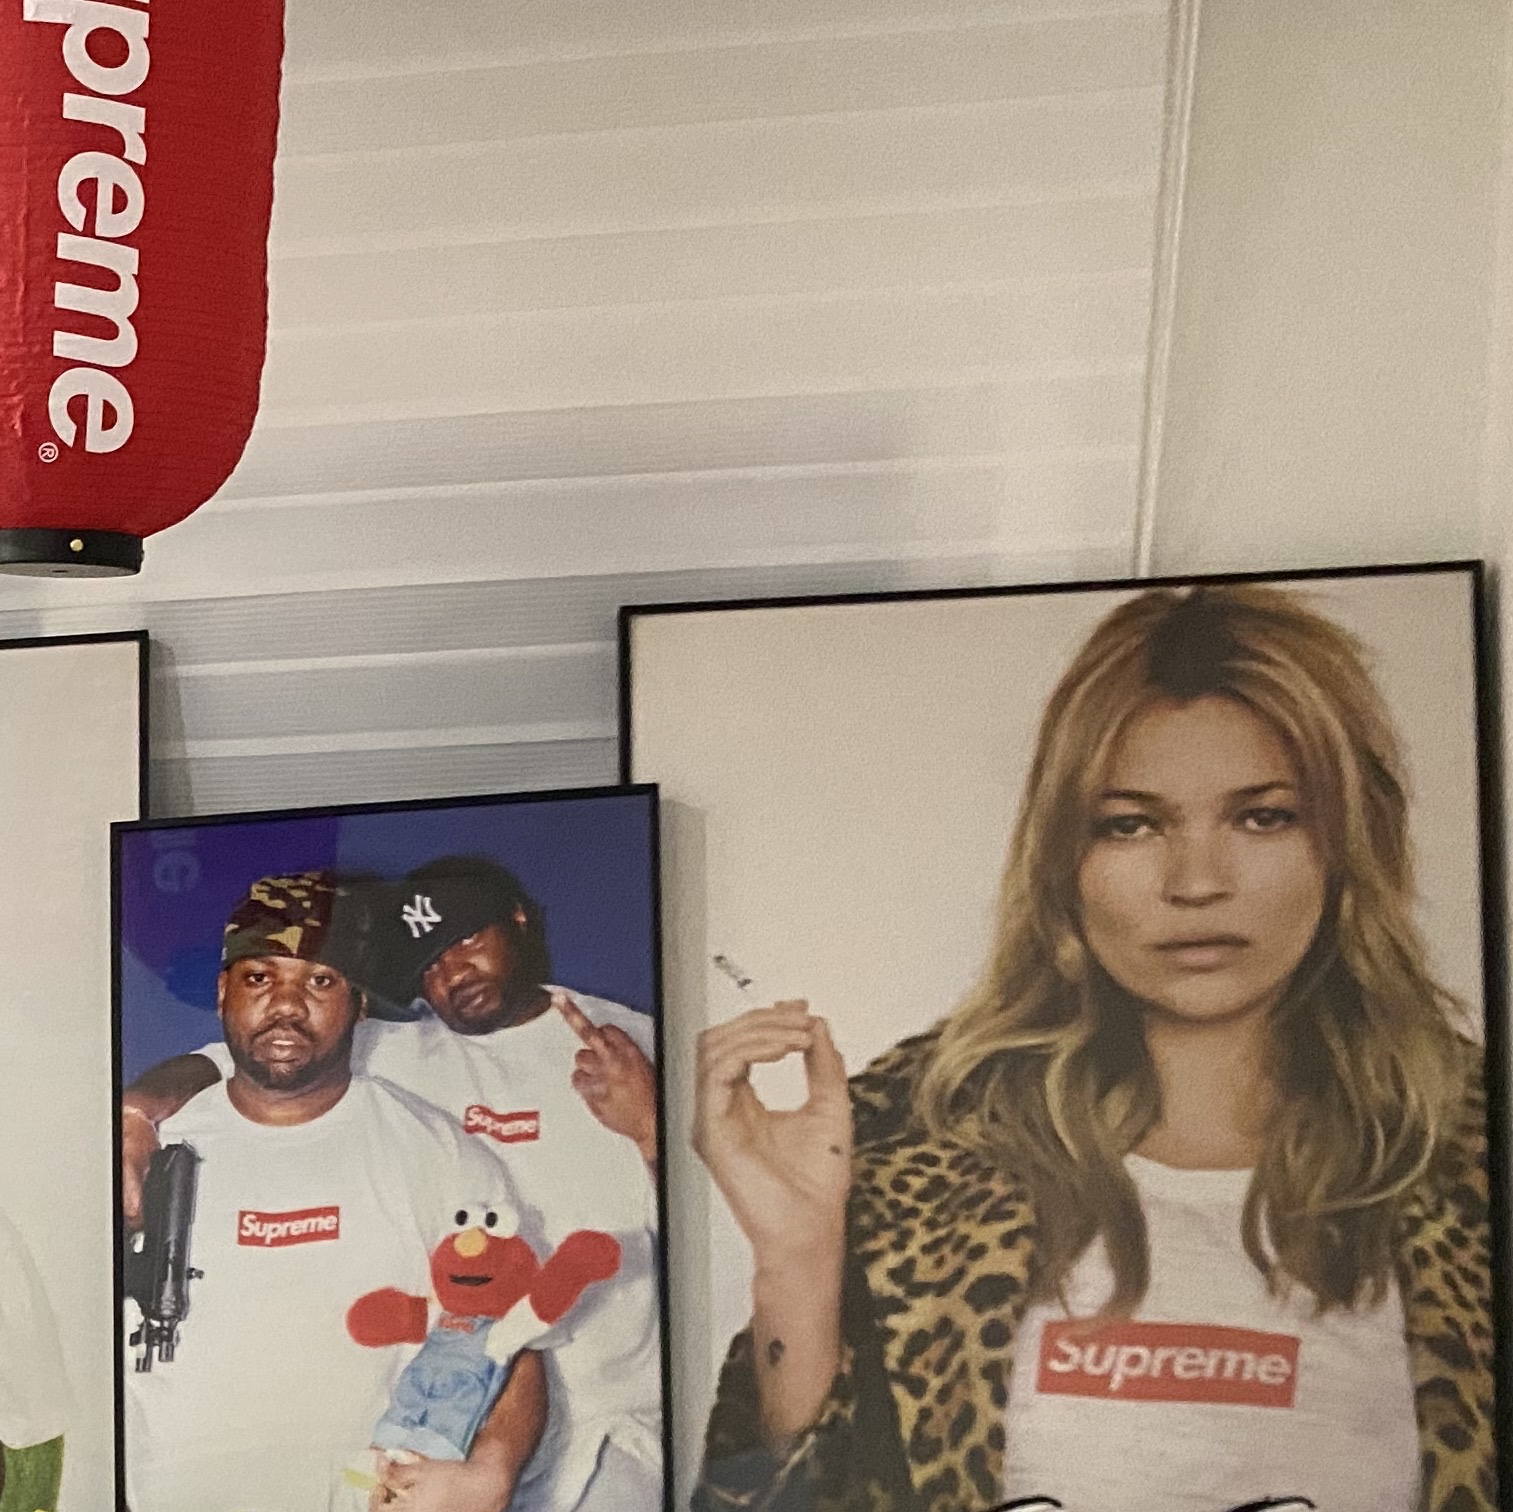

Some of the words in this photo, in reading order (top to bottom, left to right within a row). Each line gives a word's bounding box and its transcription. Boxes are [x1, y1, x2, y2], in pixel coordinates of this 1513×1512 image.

[23, 0, 151, 454] preme
[401, 894, 442, 938] NY
[240, 1214, 338, 1245] Supreme
[1048, 1337, 1292, 1391] Supreme
